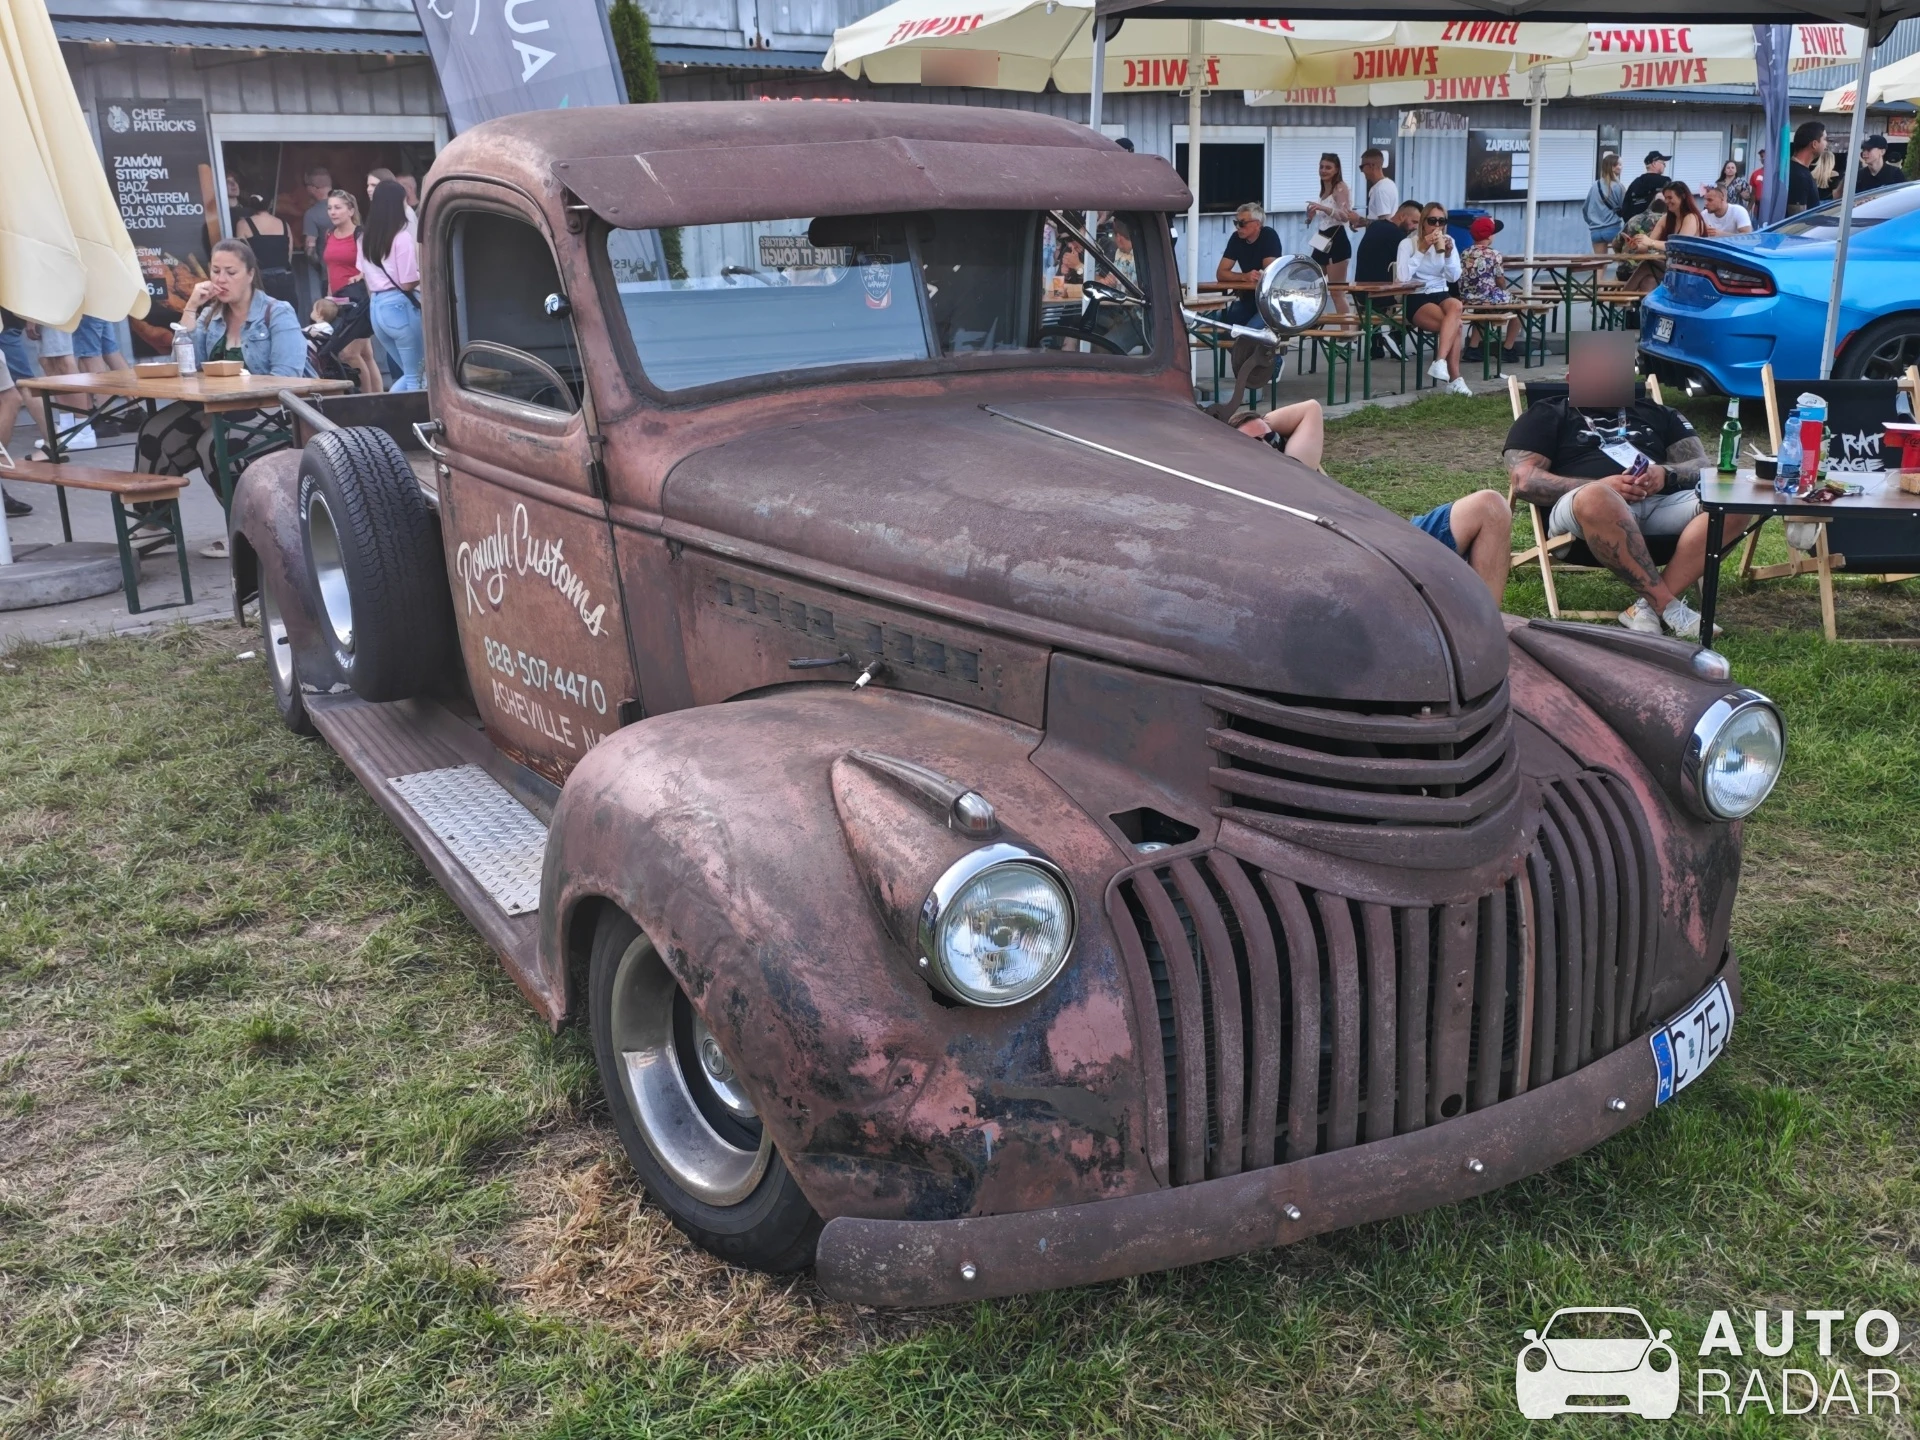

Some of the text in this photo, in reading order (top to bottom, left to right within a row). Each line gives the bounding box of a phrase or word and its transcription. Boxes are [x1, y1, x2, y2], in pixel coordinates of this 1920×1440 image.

[131, 108, 166, 120] CHEF
[133, 120, 197, 132] PATRICK'S
[1486, 139, 1530, 151] ZAPIEKANK
[113, 153, 162, 168] ZAMÓW
[115, 168, 169, 180] STRIPSY!
[119, 192, 190, 205] BOHATEREM
[121, 204, 204, 218] DLA SWOJEGO
[124, 218, 166, 230] GŁODU.
[146, 282, 156, 295] 6
[1841, 428, 1886, 460] RAT
[1826, 456, 1885, 473] RAGE
[457, 512, 513, 617] Rough
[512, 502, 609, 637] Customs
[491, 678, 577, 750] ASHEVILLE
[1660, 1075, 1671, 1094] PL
